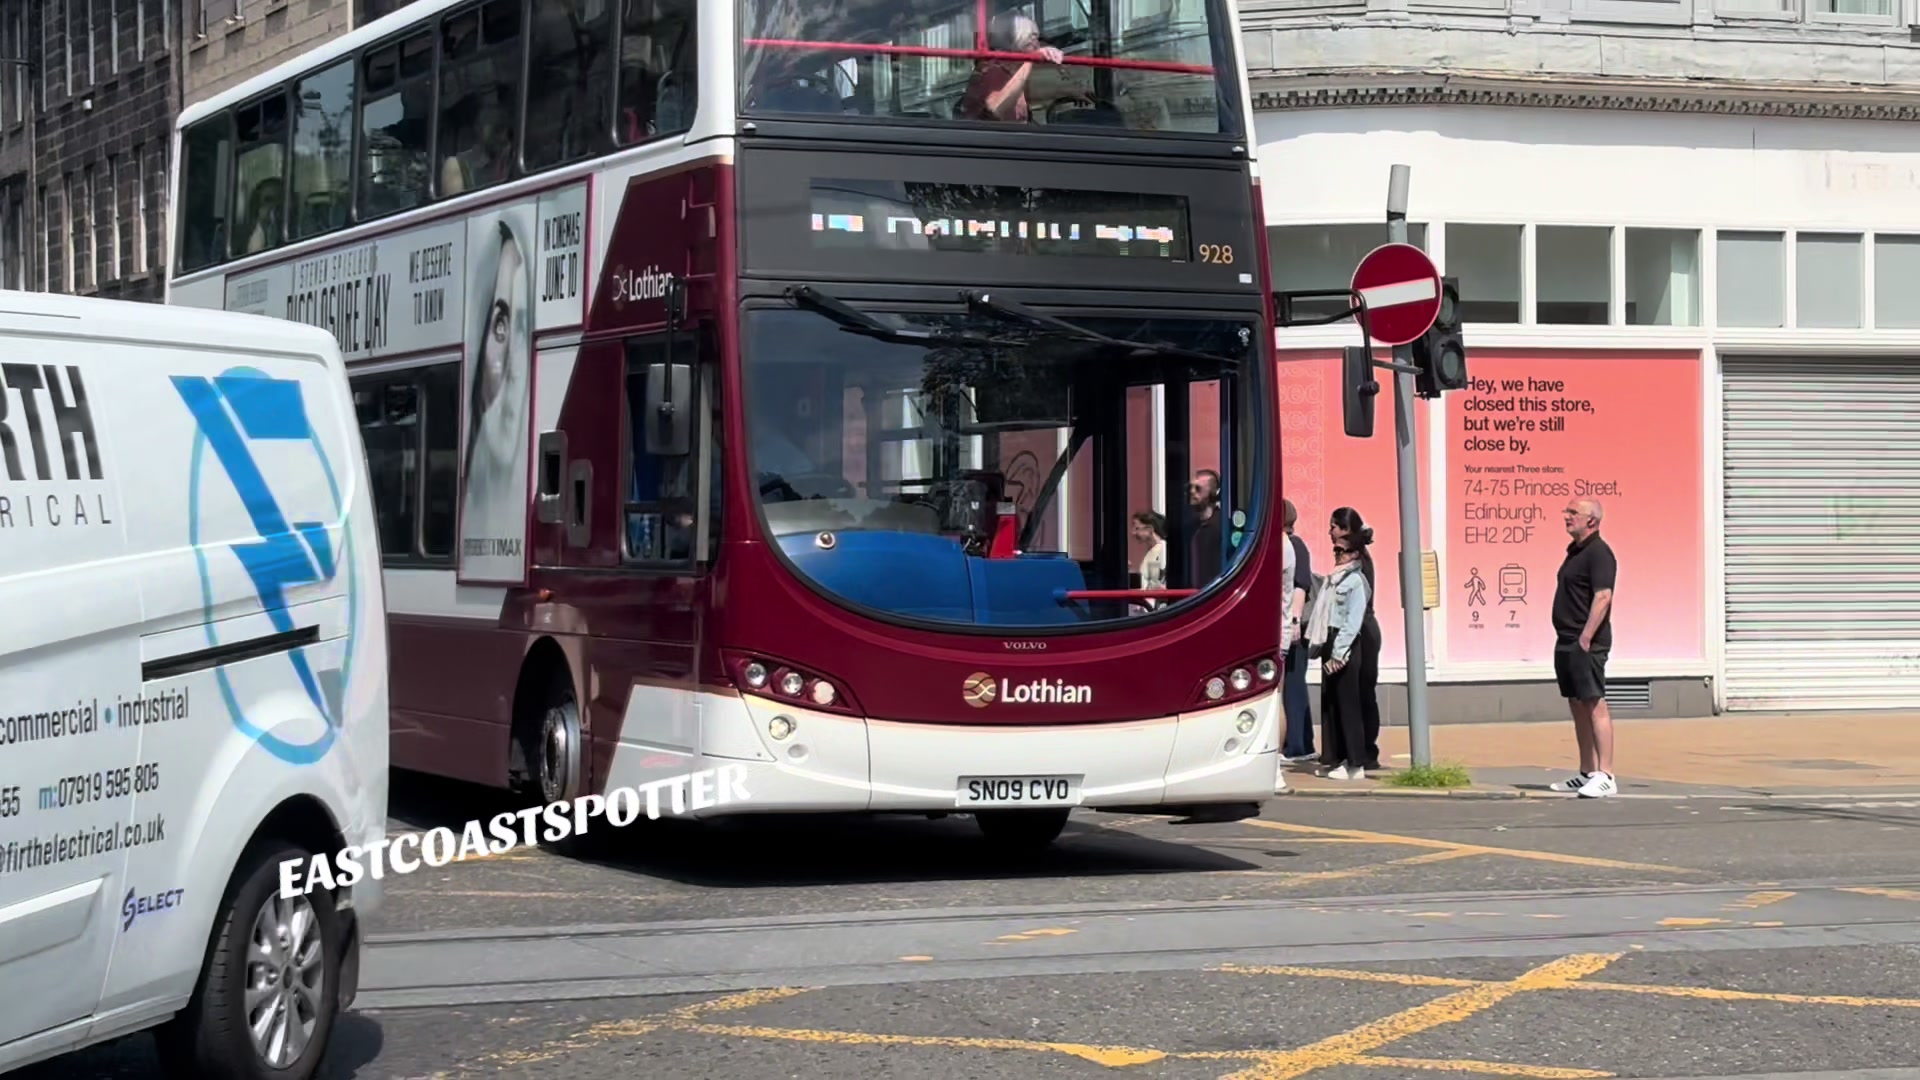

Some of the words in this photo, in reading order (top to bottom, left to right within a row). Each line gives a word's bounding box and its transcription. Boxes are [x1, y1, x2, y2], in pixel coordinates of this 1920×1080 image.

[552, 212, 580, 249] CINEMAS
[422, 242, 452, 281] DESERVE
[1199, 244, 1234, 264] 928
[542, 254, 566, 301] JUNE
[568, 252, 578, 298] 10
[365, 273, 391, 349] DAY
[1465, 376, 1497, 394] Hey,
[1501, 379, 1524, 391] we
[1528, 377, 1564, 391] have
[1464, 396, 1514, 411] closed
[1519, 397, 1547, 411] this
[1551, 398, 1595, 414] store,
[1464, 416, 1489, 431] but
[1494, 416, 1535, 431] we're
[1540, 416, 1565, 431] still
[1464, 436, 1505, 451] close
[1510, 436, 1531, 454] by.
[1464, 465, 1482, 473] Your
[1484, 465, 1514, 473] nearest
[1517, 464, 1540, 473] Three
[1464, 480, 1509, 496] 74-75
[1514, 479, 1569, 496] Princes
[1574, 479, 1622, 497] Street,
[1465, 503, 1546, 523] Edinburgh,
[1465, 527, 1498, 543] EH2
[1503, 526, 1535, 543] 2DF
[1472, 610, 1479, 622] 9
[1510, 610, 1516, 620] 7
[1003, 641, 1047, 650] VOLVO
[1001, 677, 1092, 703] Lothian
[118, 686, 189, 728] industrial
[106, 768, 131, 799] 595
[134, 763, 159, 793] 805
[969, 780, 1023, 800] SN09
[1029, 779, 1069, 800] CVO
